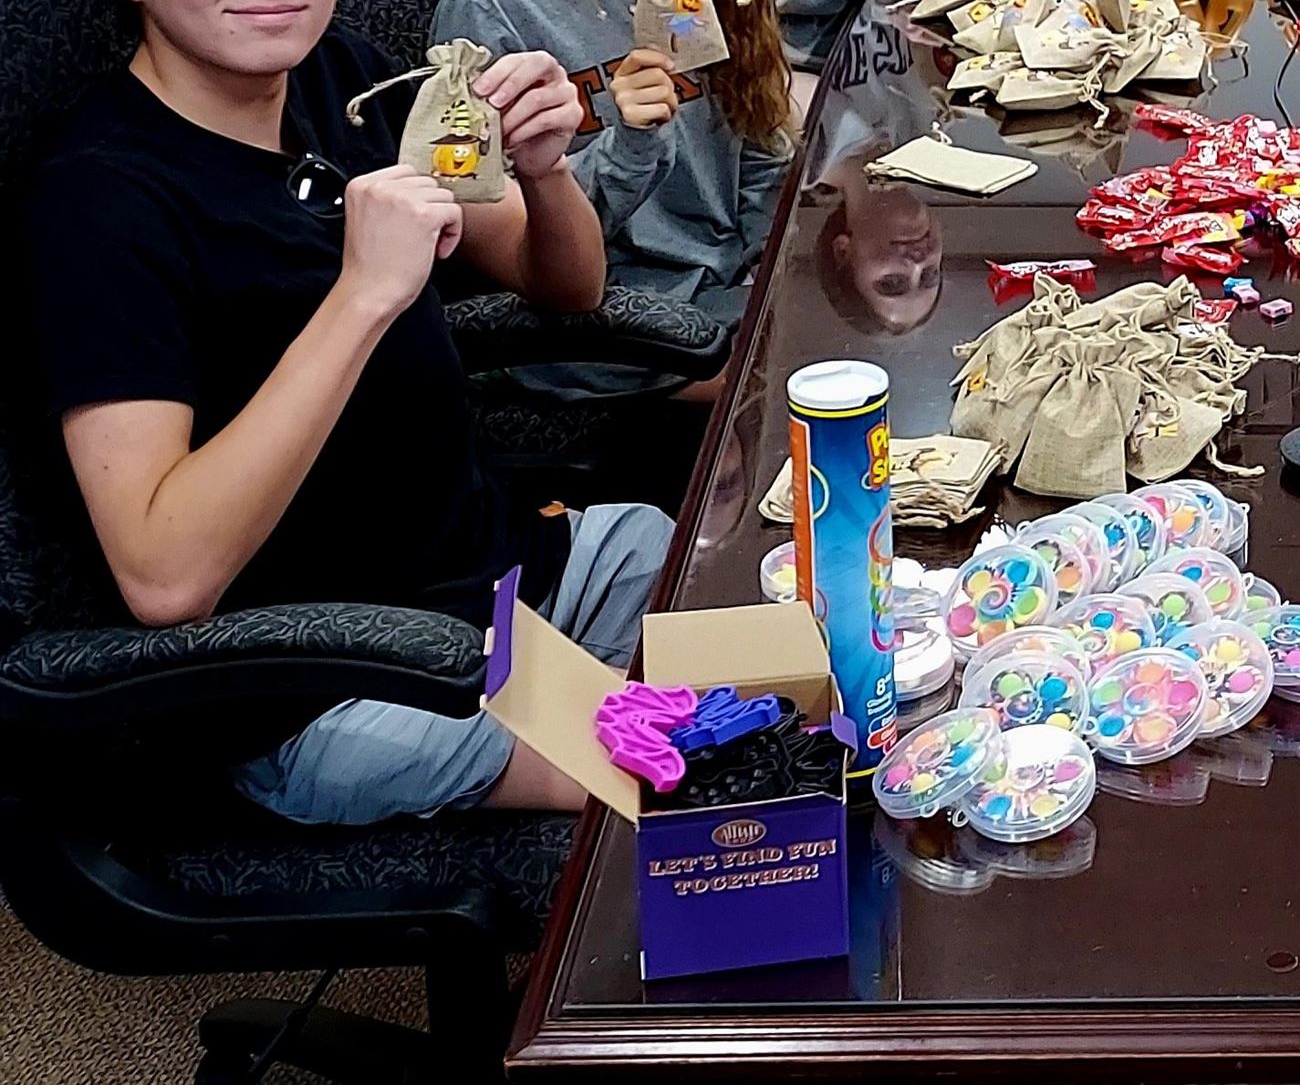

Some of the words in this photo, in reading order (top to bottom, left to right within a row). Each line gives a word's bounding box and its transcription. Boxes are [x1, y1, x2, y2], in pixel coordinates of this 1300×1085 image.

[649, 855, 717, 876] LET'S
[720, 847, 783, 869] FIND
[788, 839, 837, 860] FUN
[674, 864, 819, 895] TOGETHER!
